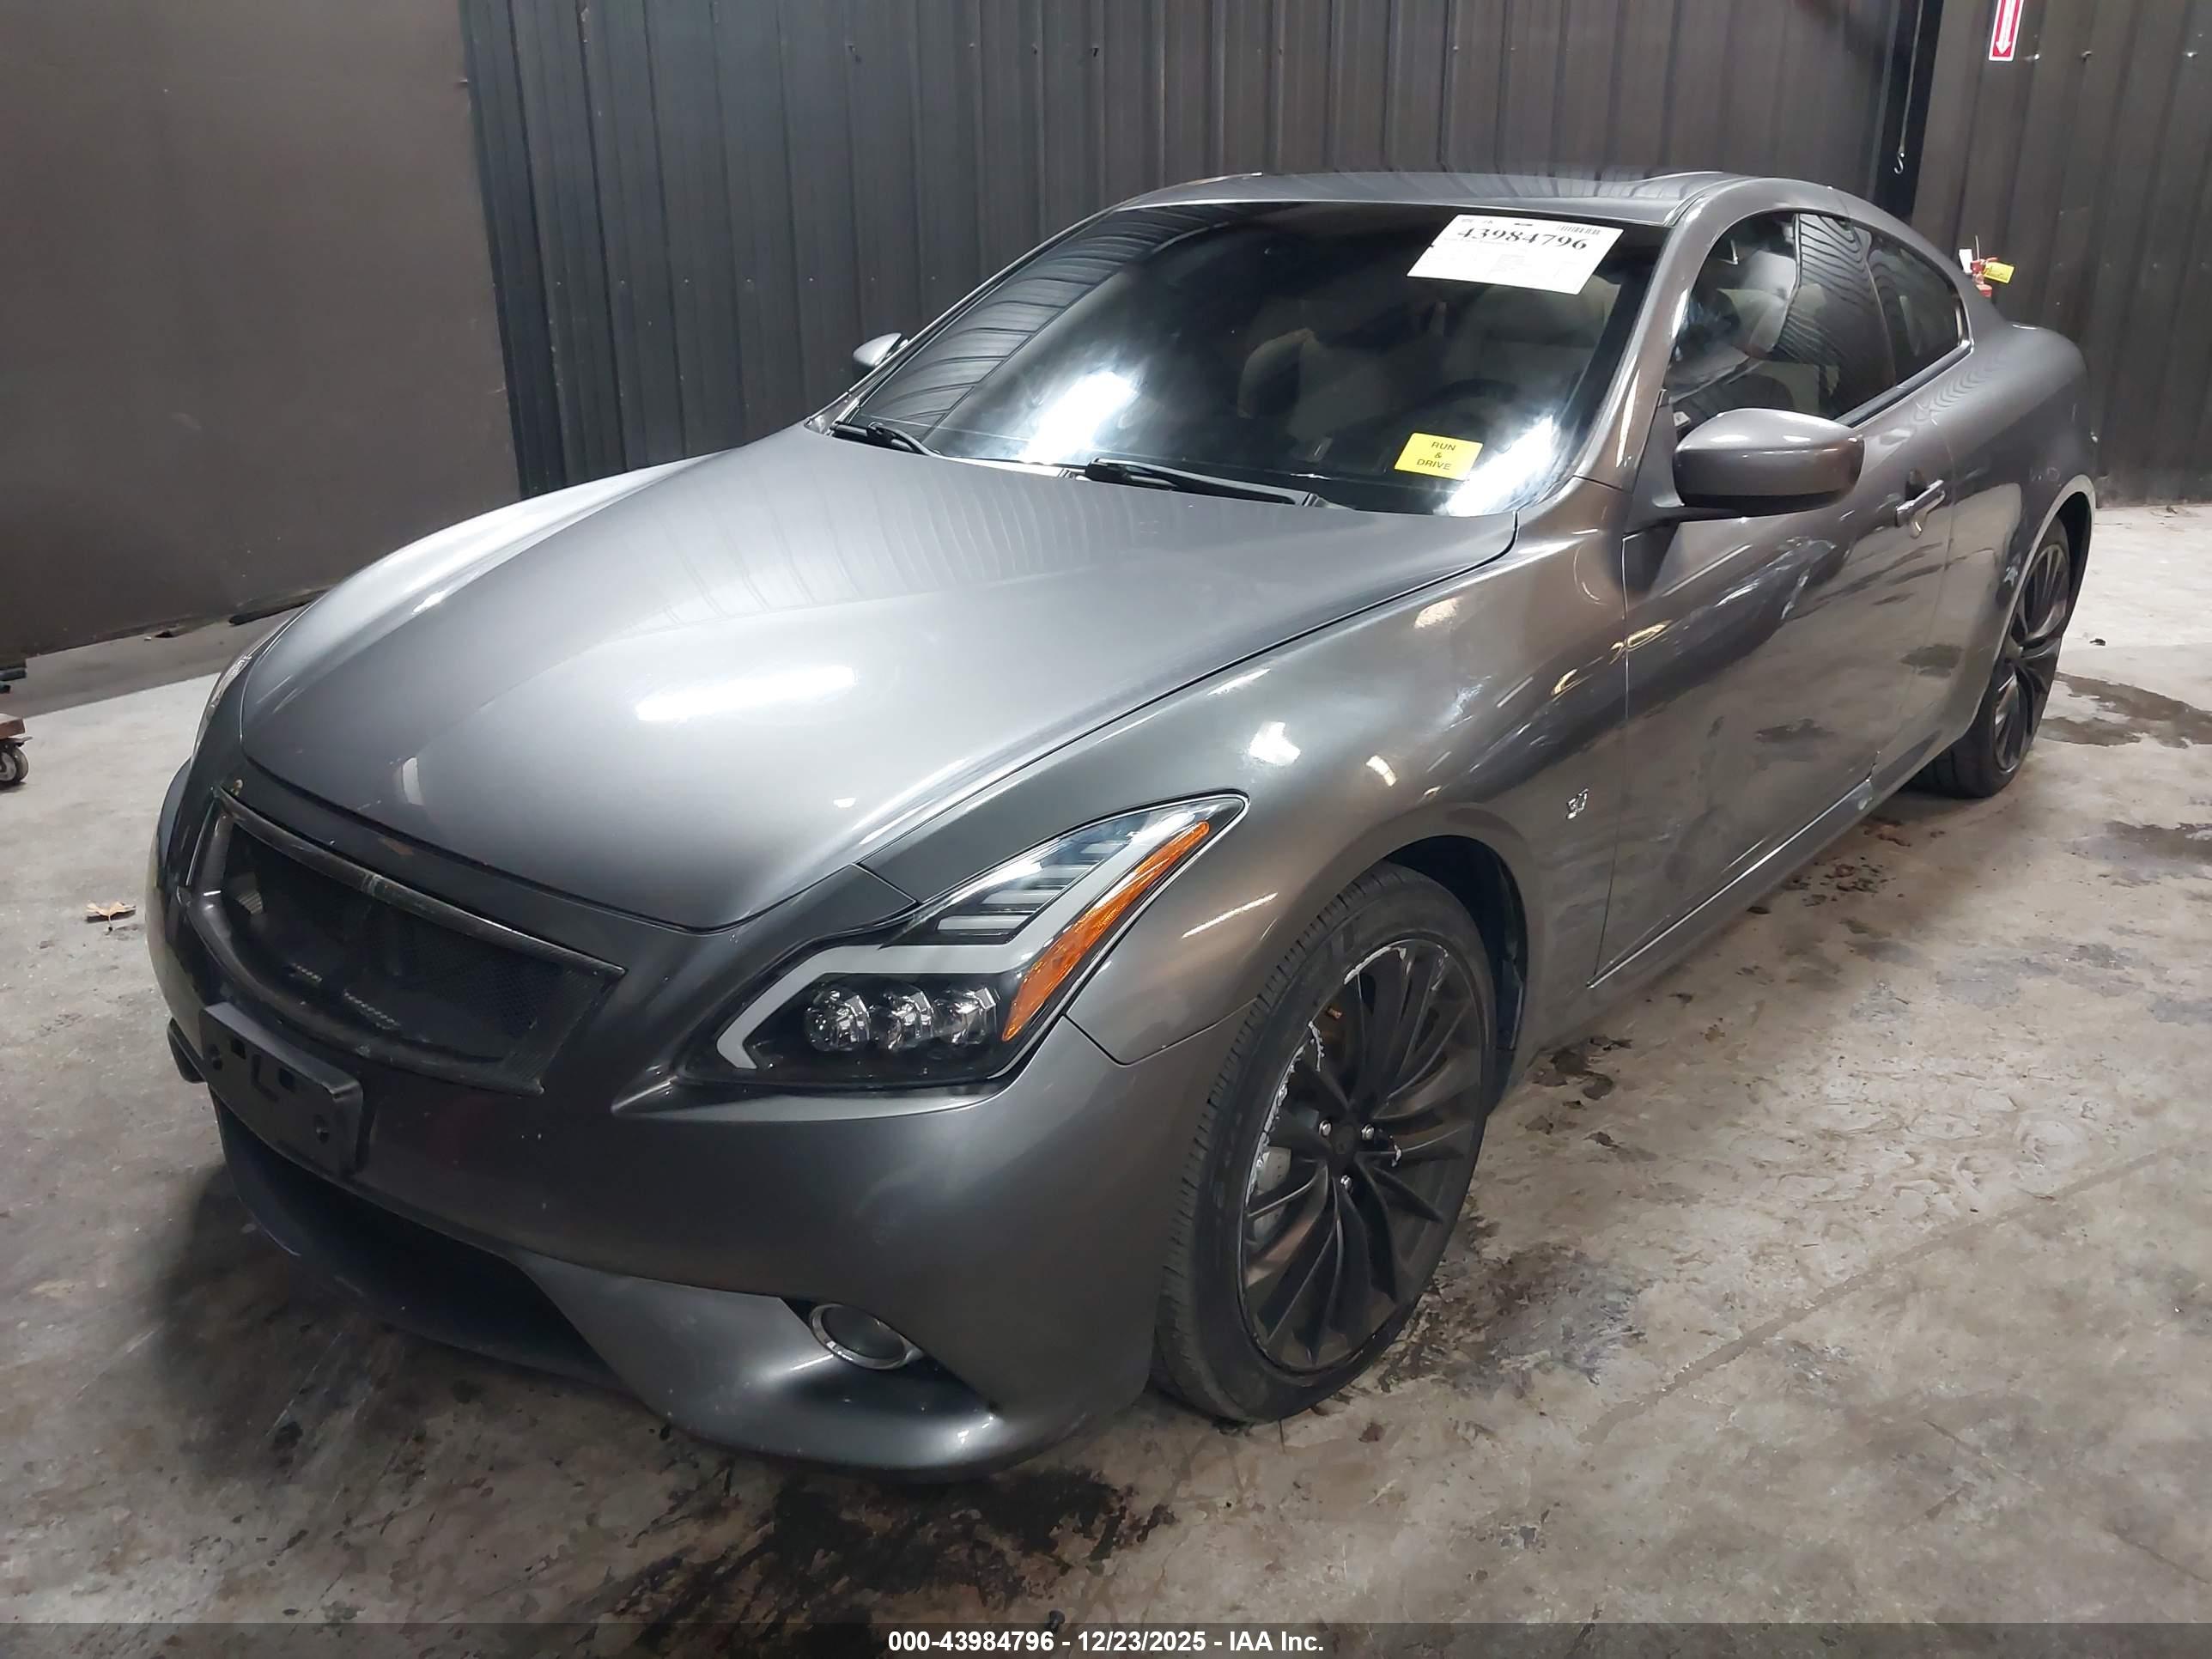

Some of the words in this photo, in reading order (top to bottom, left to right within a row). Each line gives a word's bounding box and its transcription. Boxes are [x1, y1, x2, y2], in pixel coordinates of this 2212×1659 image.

[1457, 228, 1588, 250] 43984796
[1431, 441, 1456, 451] RUN
[1417, 459, 1453, 471] DRIVE
